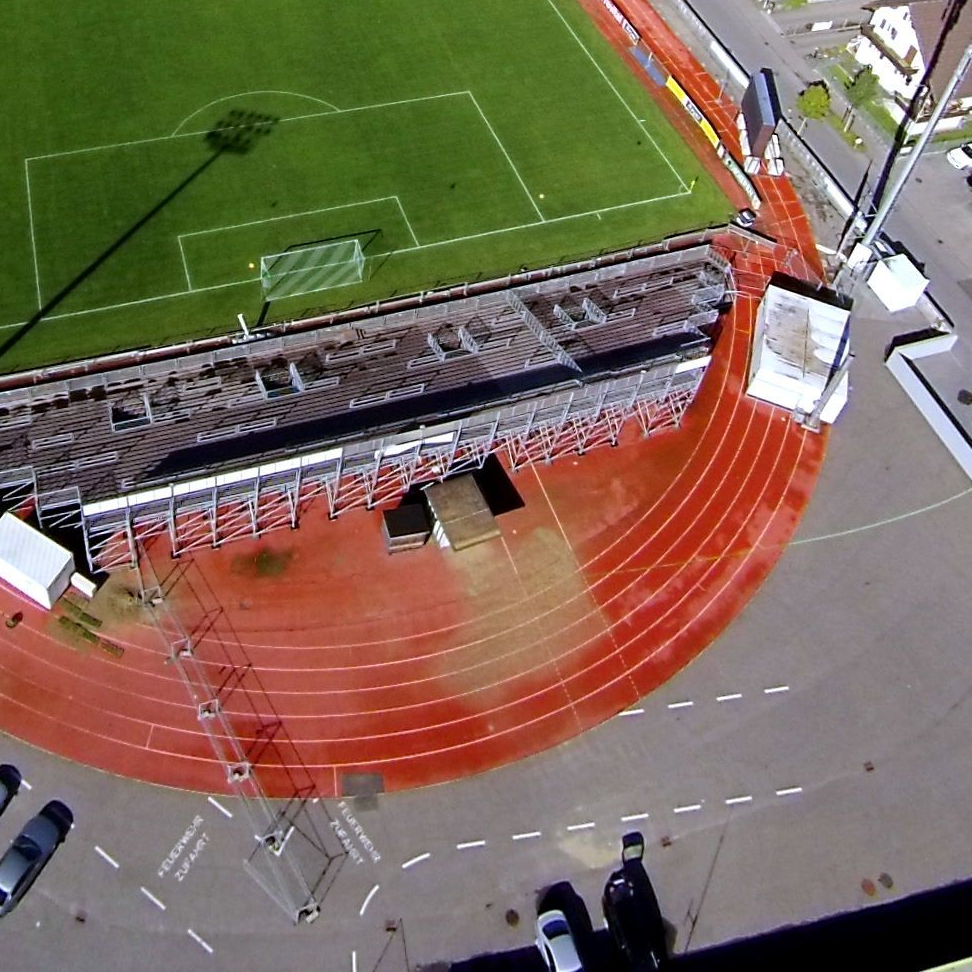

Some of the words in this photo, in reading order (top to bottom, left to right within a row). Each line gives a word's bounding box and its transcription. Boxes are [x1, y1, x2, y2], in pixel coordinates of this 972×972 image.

[158, 815, 204, 878] FEUERWEHR
[175, 832, 209, 881] ZUFAHRT
[329, 819, 363, 864] ZUFAHRT
[338, 801, 381, 863] FEUERWEHR
